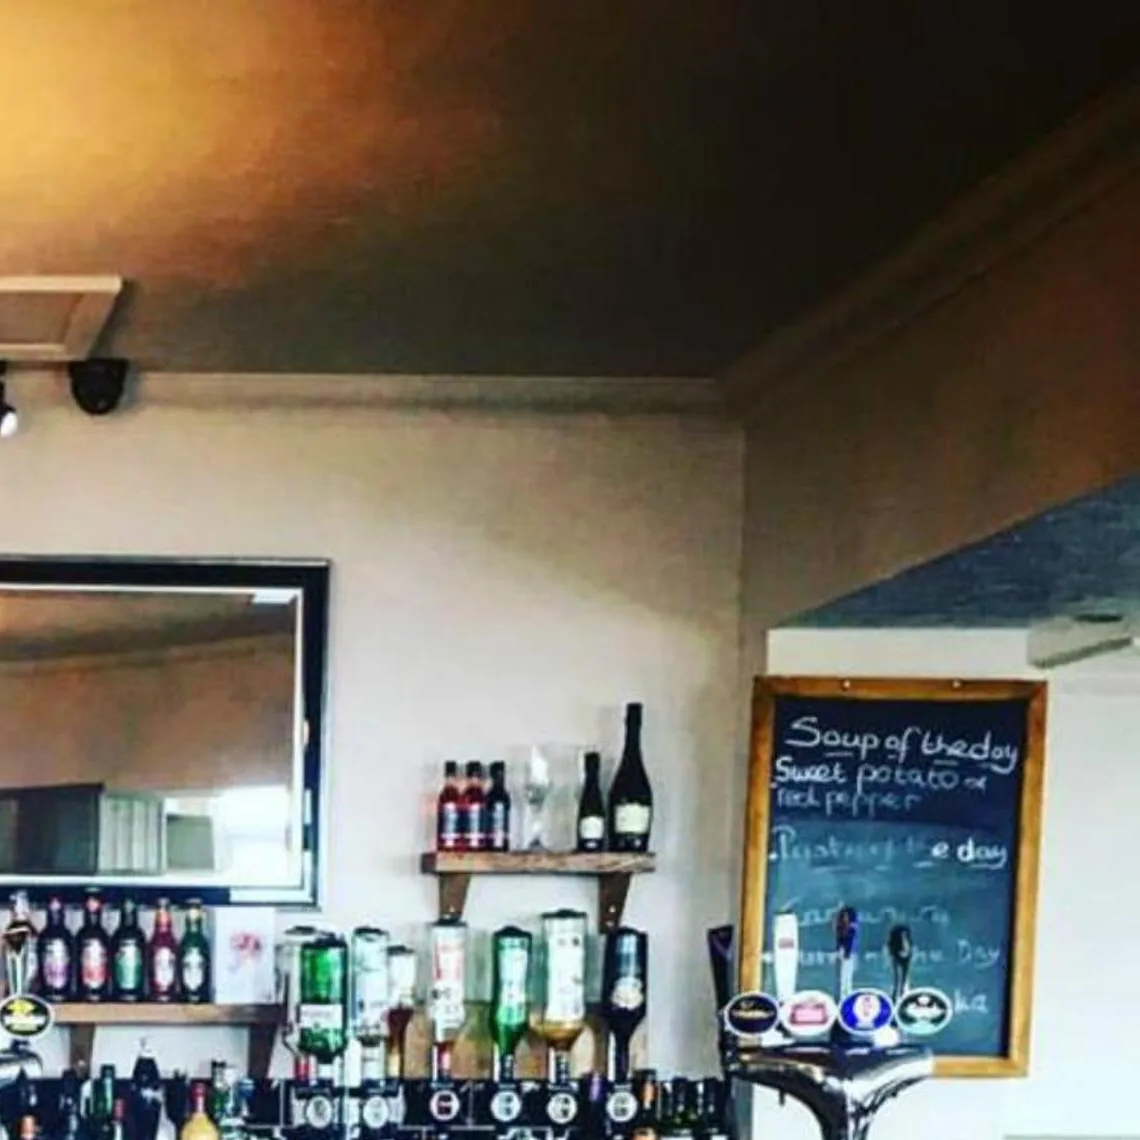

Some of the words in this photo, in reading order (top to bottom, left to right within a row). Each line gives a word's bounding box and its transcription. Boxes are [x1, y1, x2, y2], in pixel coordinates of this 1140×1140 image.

[784, 716, 880, 760] Soup
[884, 726, 922, 763] of
[921, 730, 967, 760] the
[966, 730, 1017, 775] day
[775, 755, 847, 784] Sweet
[856, 762, 960, 795] potato
[825, 789, 923, 817] pepper
[956, 836, 1008, 870] day
